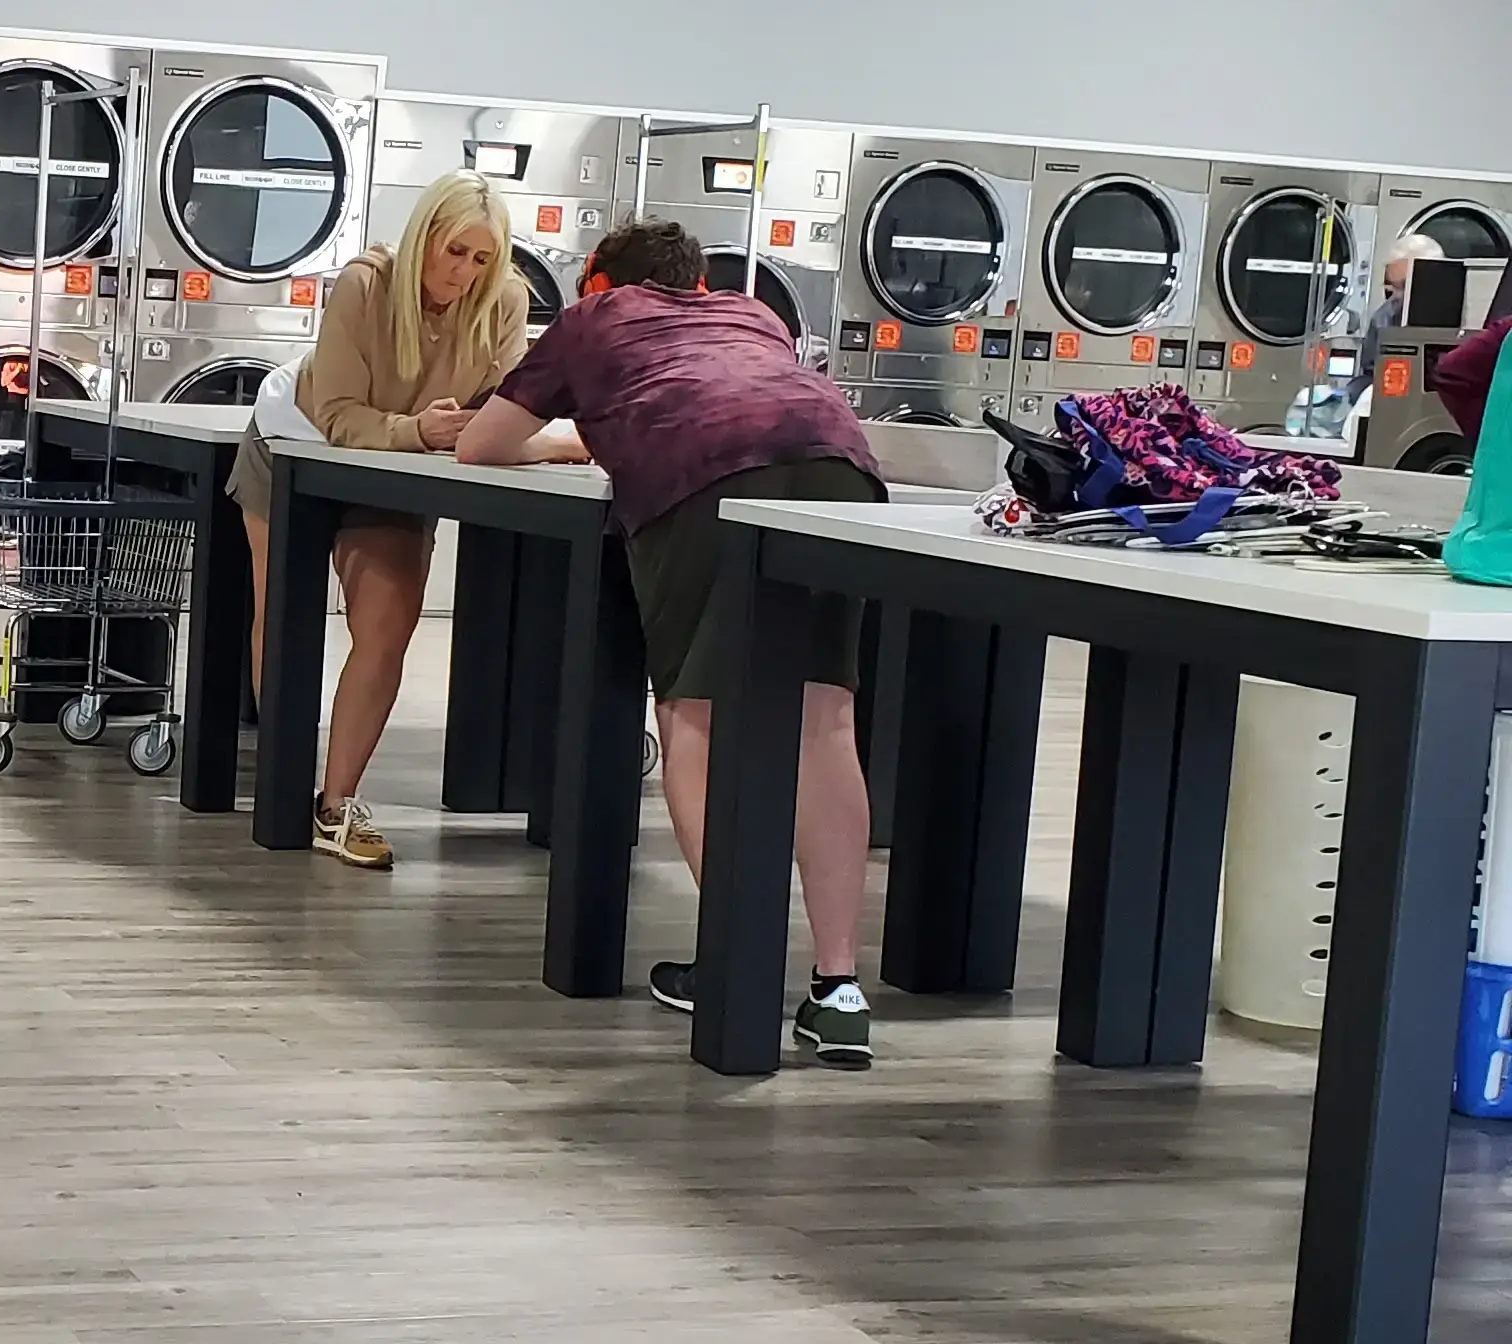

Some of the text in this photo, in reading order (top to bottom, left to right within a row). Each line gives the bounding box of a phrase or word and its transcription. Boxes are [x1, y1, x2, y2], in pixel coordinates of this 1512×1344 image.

[56, 164, 101, 173] CLOSE GENTLY
[199, 172, 231, 181] FILL LINE
[838, 993, 861, 1005] NIKE
